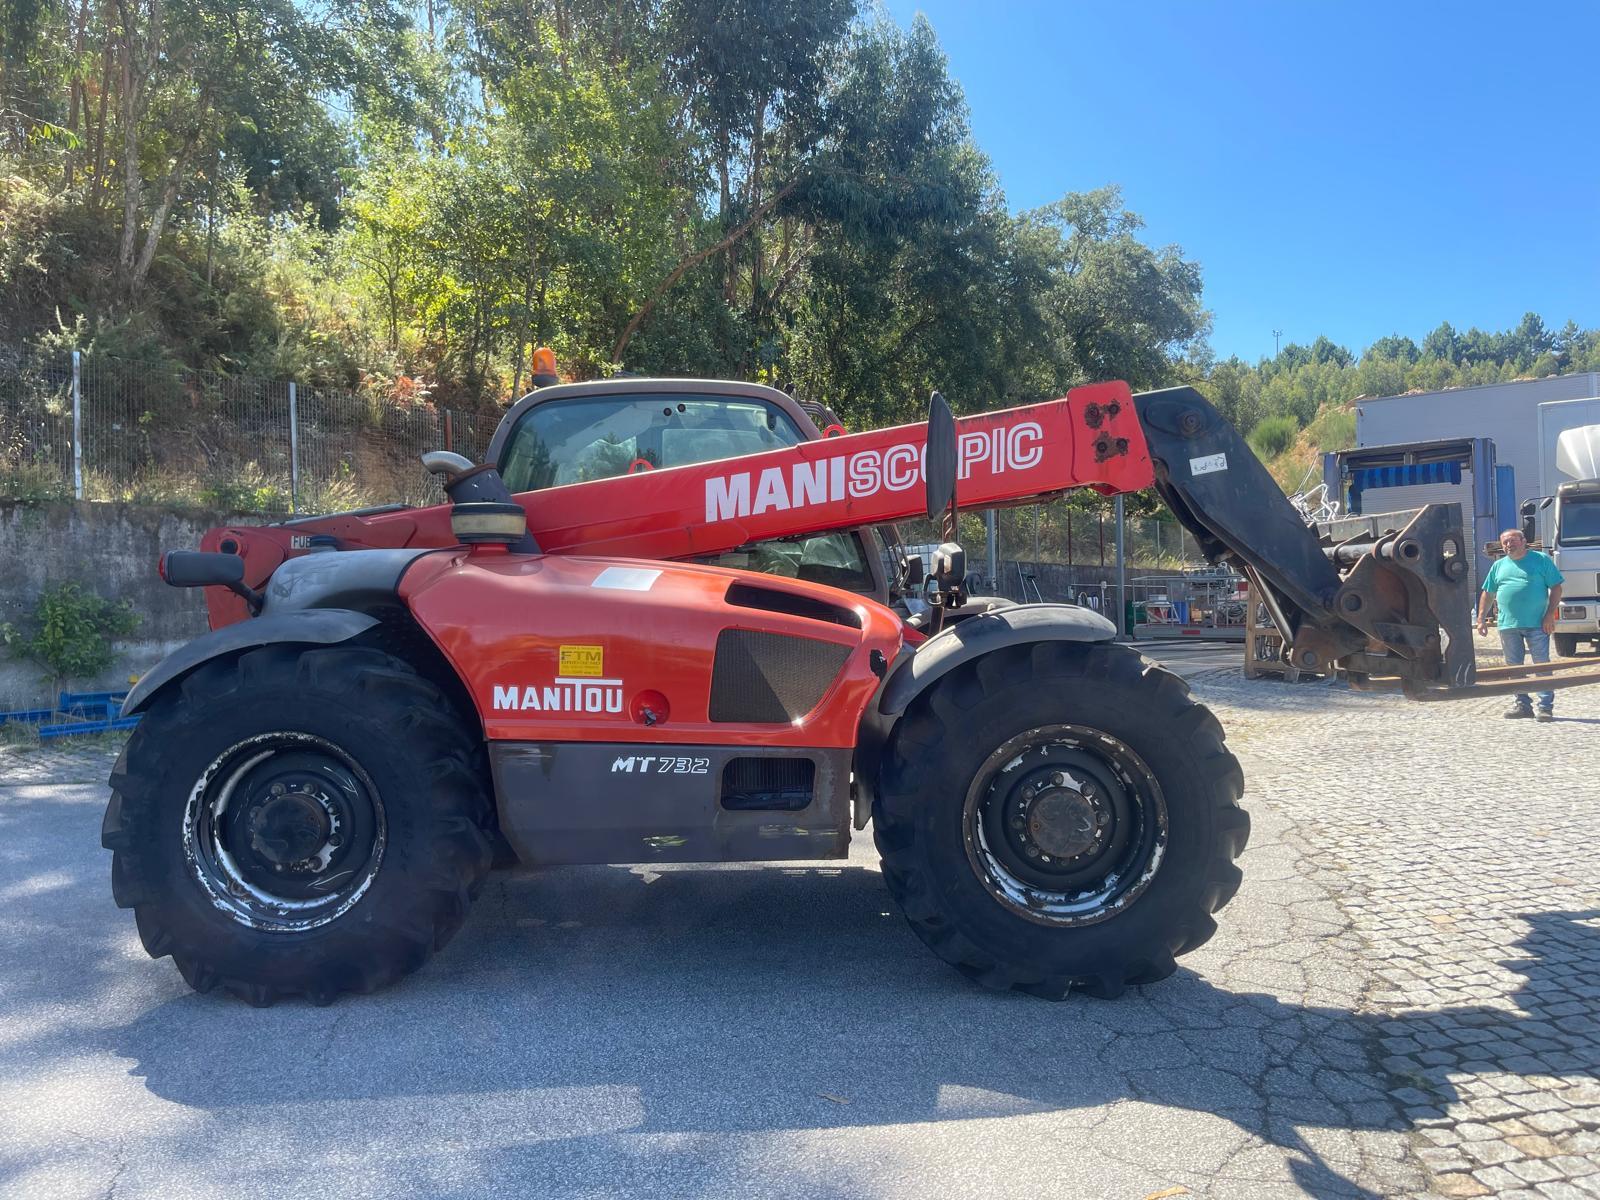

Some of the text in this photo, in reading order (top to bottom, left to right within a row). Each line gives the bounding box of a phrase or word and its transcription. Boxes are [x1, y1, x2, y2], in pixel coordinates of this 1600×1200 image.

[705, 422, 1043, 523] MANISCPIC
[493, 678, 623, 713] MANITOU
[611, 756, 710, 774] MT 732
